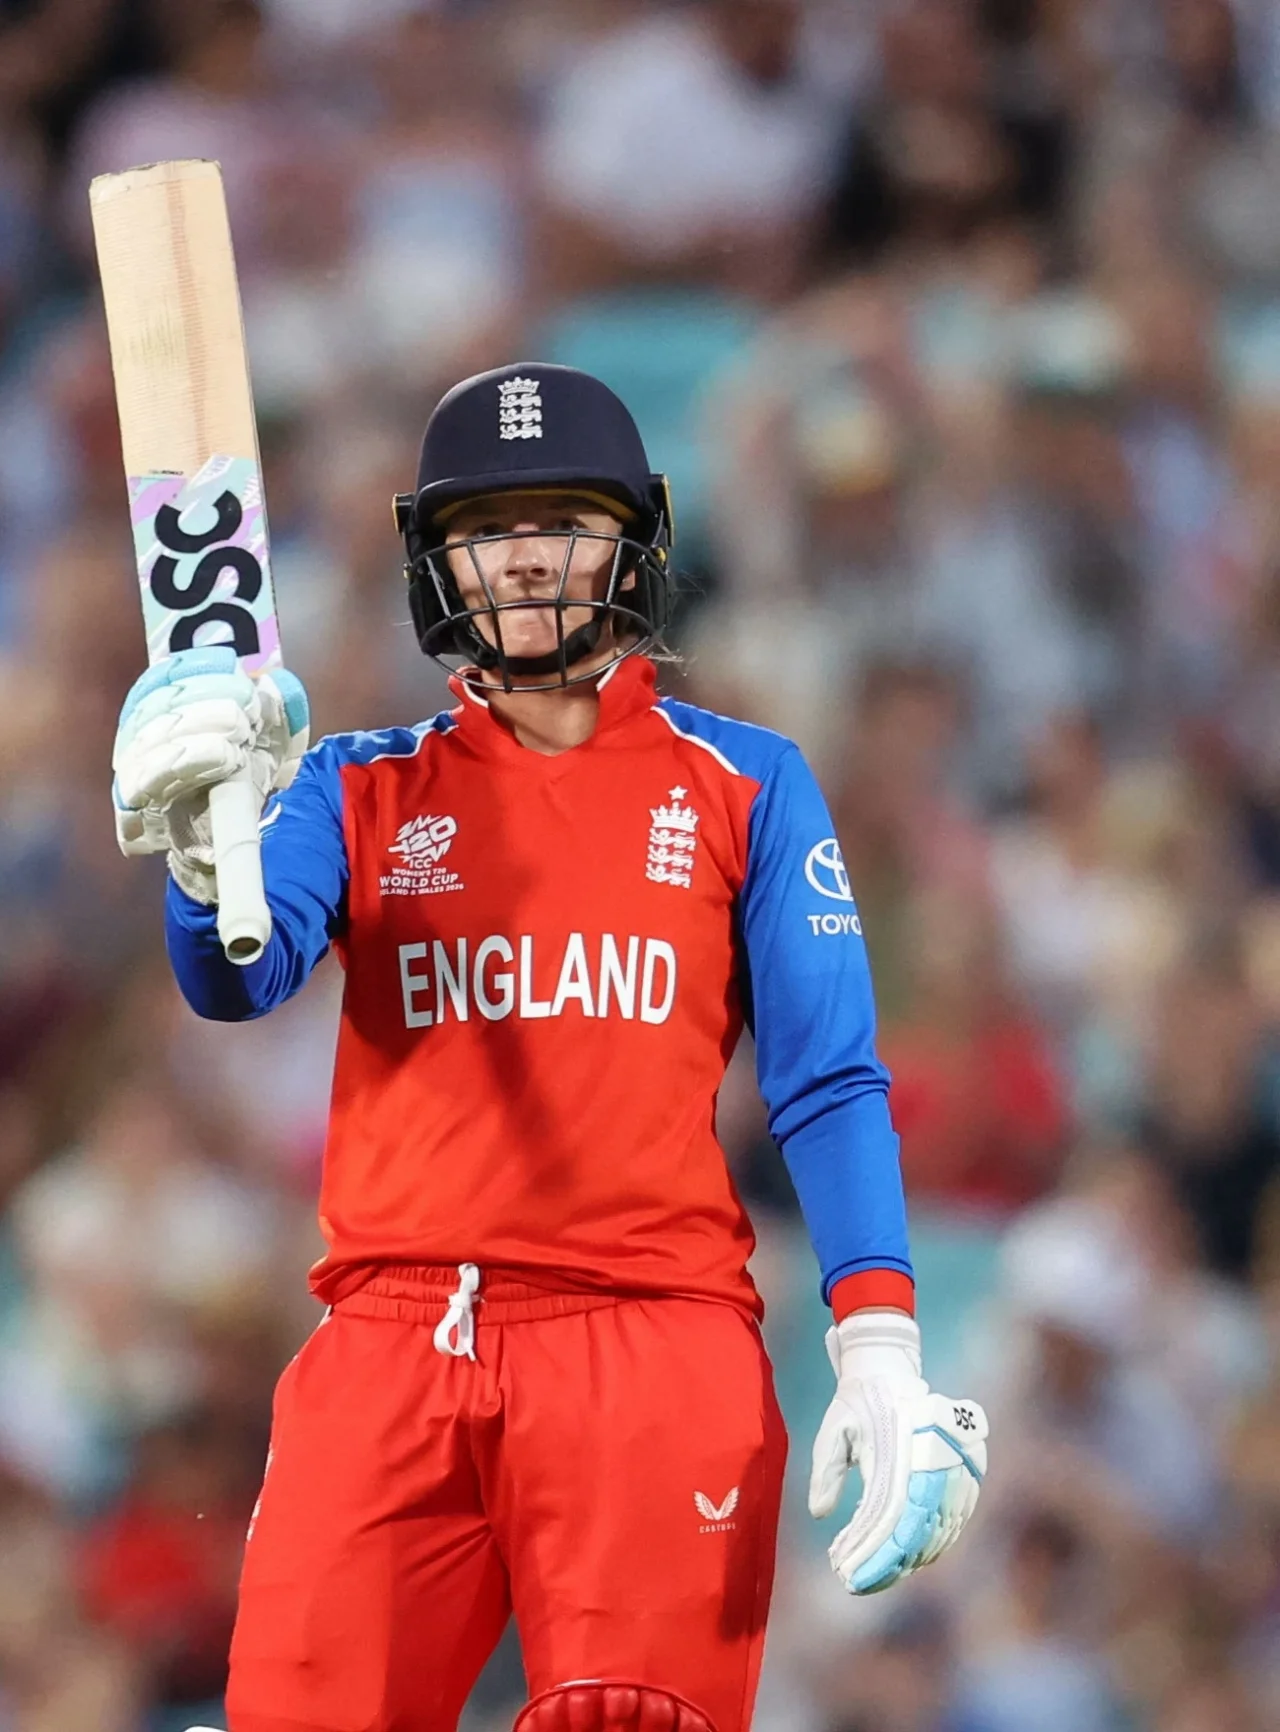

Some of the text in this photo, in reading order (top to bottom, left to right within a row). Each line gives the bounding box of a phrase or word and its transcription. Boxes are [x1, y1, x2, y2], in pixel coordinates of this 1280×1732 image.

[150, 489, 262, 657] DSC
[409, 858, 432, 869] ICC
[379, 873, 459, 888] WORLD CUP
[418, 885, 444, 895] WALES
[807, 913, 862, 936] TOYO
[398, 932, 677, 1029] ENGLAND
[953, 1407, 976, 1430] DSC
